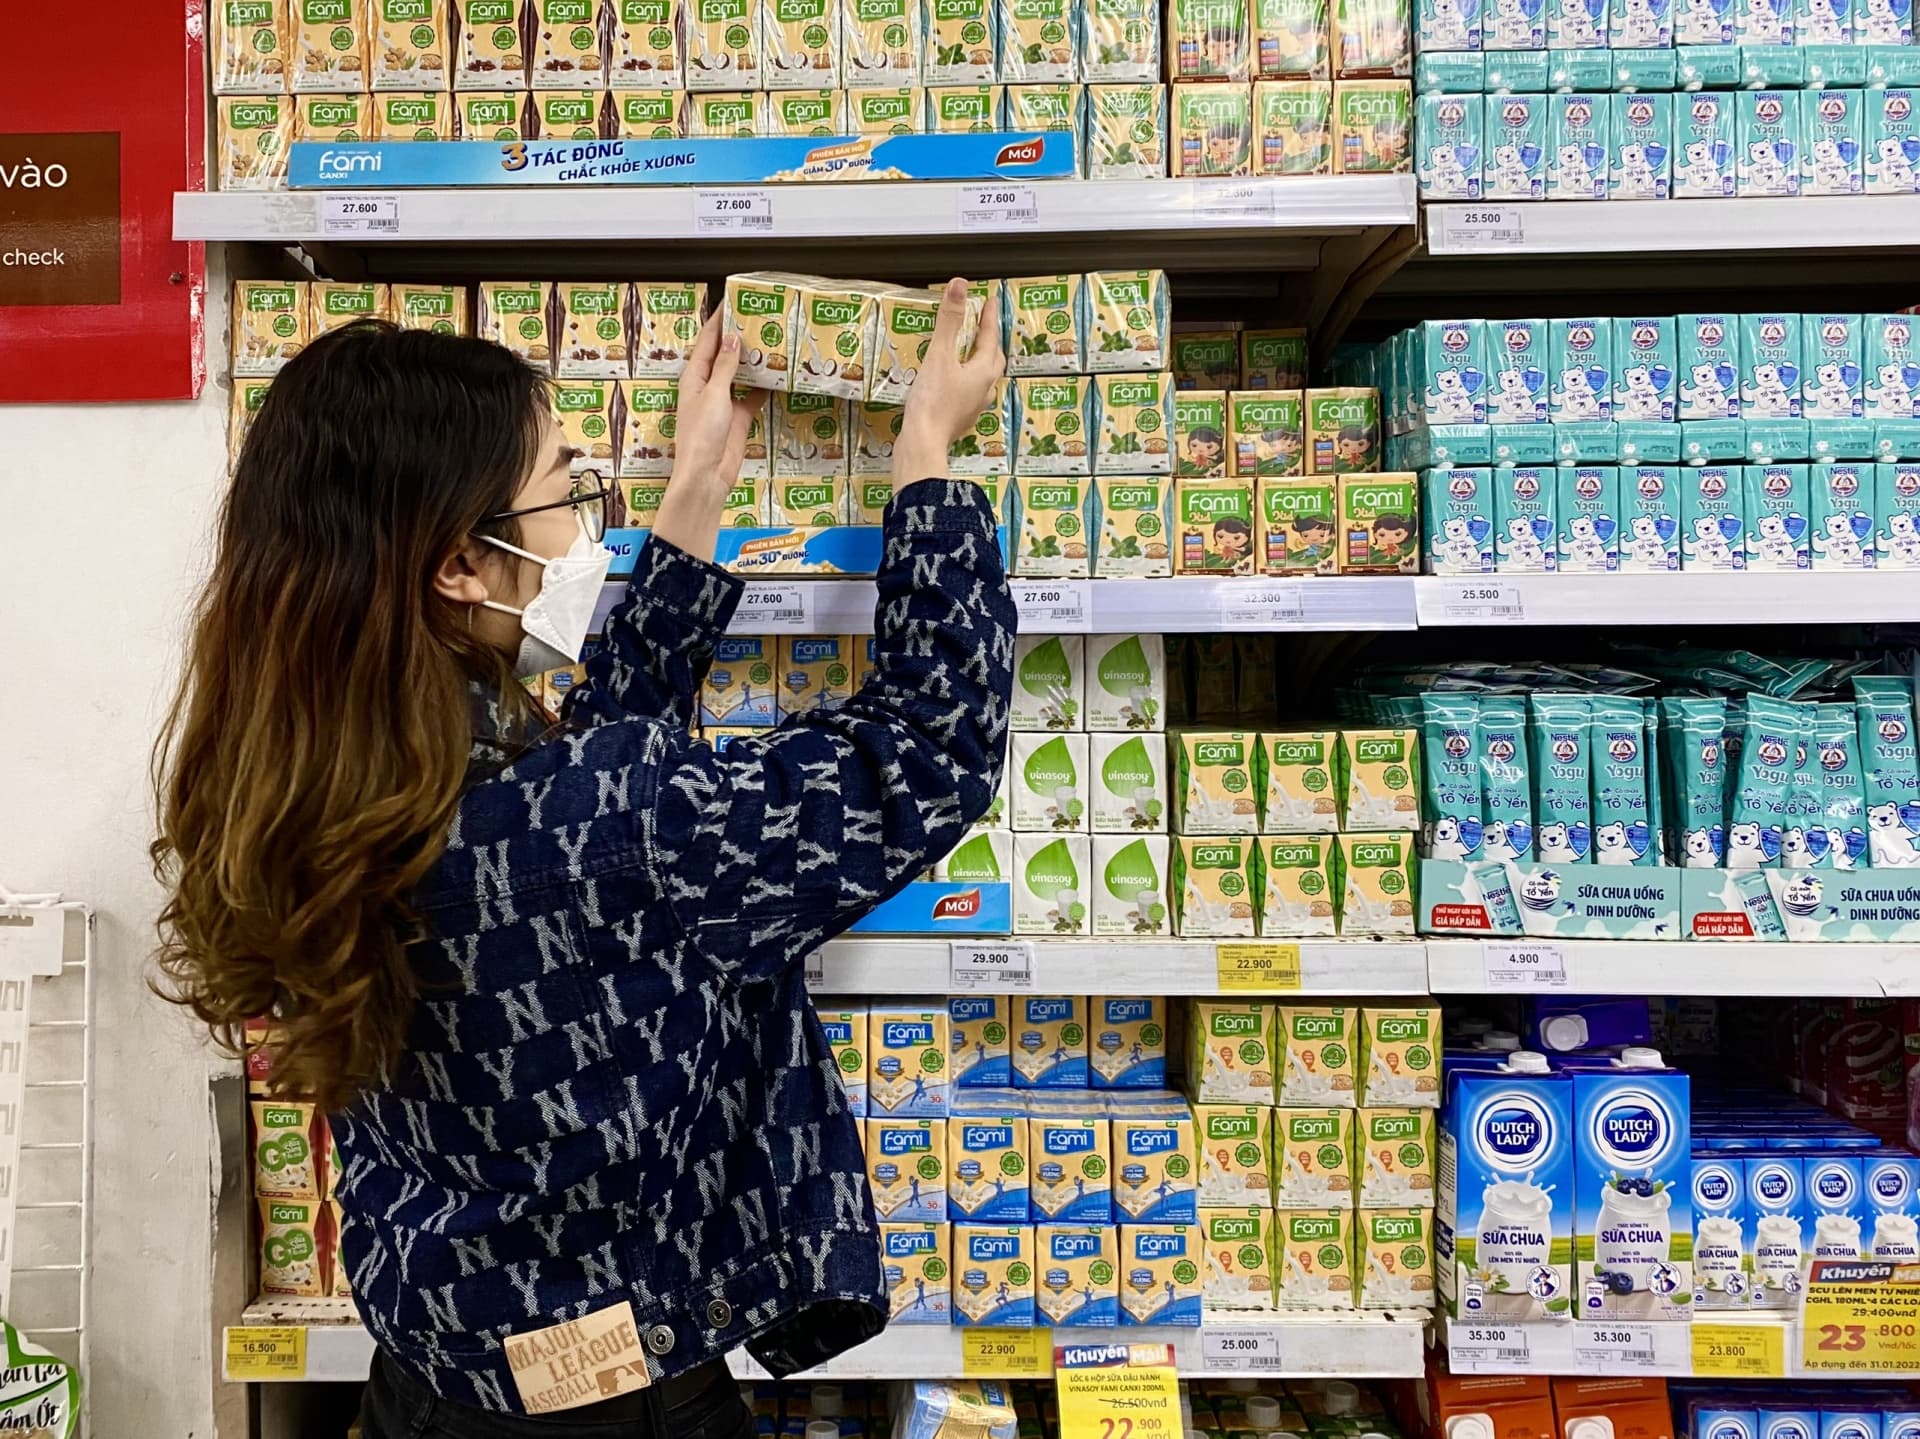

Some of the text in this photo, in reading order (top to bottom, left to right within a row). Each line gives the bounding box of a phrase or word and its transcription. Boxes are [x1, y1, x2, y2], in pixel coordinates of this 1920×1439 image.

[234, 106, 272, 121] Fami
[627, 100, 667, 116] Fami
[1186, 96, 1238, 117] Fami
[501, 141, 625, 172] 3 TÁC ĐỘNG
[1008, 146, 1038, 160] MỚI
[319, 152, 382, 171] Fami
[559, 152, 696, 181] CHẮC KHỎE XƯƠNG
[0, 160, 68, 189] vào
[715, 200, 751, 211] 27.600
[979, 193, 1015, 205] 27.600
[342, 203, 378, 214] 27.600
[1464, 213, 1501, 224] 25.500
[2, 249, 65, 267] check
[498, 292, 535, 308] Fami
[1023, 286, 1061, 301] Fami
[816, 302, 854, 321] Fami
[1111, 382, 1152, 399] Fami
[1241, 403, 1289, 422] Fami
[1318, 400, 1366, 419] Fami
[789, 486, 827, 503] Fami
[1188, 493, 1240, 513] Fami
[747, 593, 783, 605] 27.600
[1023, 591, 1060, 603] 27.600
[1462, 589, 1500, 600] 25.500
[1198, 743, 1237, 759] Fami
[1360, 741, 1398, 757] Fami
[1029, 770, 1071, 784] vinasoy
[1108, 768, 1150, 784] vinasoy
[1550, 766, 1585, 780] Yogu
[1196, 845, 1235, 861] Fami
[1030, 872, 1074, 886] vinasoy
[1110, 873, 1153, 887] vinasoy
[1578, 883, 1665, 901] SỮA CHUA UỐNG
[1841, 887, 1862, 902] SỮA
[1865, 890, 1896, 902] CHUA
[945, 899, 973, 913] MỚI
[1586, 903, 1656, 919] DINH DƯỠNG
[1850, 906, 1920, 921] DINH DƯỠNG
[1435, 917, 1448, 926] GIÁ
[1697, 925, 1711, 935] GIÁ
[972, 953, 1009, 964] 29.900
[1236, 958, 1273, 970] 22.900
[1508, 953, 1539, 964] 4.900
[1030, 1001, 1067, 1016] Fami
[1215, 1015, 1255, 1031] Fami
[1297, 1017, 1336, 1033] Fami
[887, 1023, 926, 1040] Fami
[266, 1111, 298, 1125] Fami
[1374, 1118, 1413, 1134] Fami
[1491, 1122, 1536, 1134] DUTCH
[1609, 1120, 1653, 1132] DUTCH
[885, 1130, 923, 1146] Fami
[1048, 1132, 1088, 1148] Fami
[1496, 1133, 1531, 1146] LADY
[1614, 1131, 1649, 1144] LADY
[1376, 1220, 1414, 1235] Fami
[890, 1233, 929, 1250] Fami
[1483, 1228, 1509, 1245] SỮA
[1510, 1233, 1545, 1245] CHUA
[1602, 1228, 1627, 1243] SỮA
[1628, 1231, 1663, 1243] CHUA
[973, 1237, 1012, 1253] Fami
[1808, 1286, 1830, 1294] SCU
[1831, 1285, 1853, 1294] LÊN
[1854, 1287, 1877, 1295] MEN
[1879, 1286, 1894, 1296] TỰ
[1879, 1296, 1901, 1305] CÁC
[1468, 1330, 1506, 1342] 35.300
[1593, 1332, 1632, 1343] 35.300
[1818, 1324, 1916, 1351] 23 .800
[243, 1343, 276, 1353] 16.500
[508, 1321, 587, 1372] MAJOR
[546, 1320, 638, 1384] LEAGUE
[980, 1345, 1015, 1356] 22.900
[1221, 1339, 1258, 1351] 25.000
[1708, 1346, 1746, 1357] 23.800
[1821, 1359, 1847, 1369] dụng
[1870, 1361, 1920, 1369] 31.01.2022
